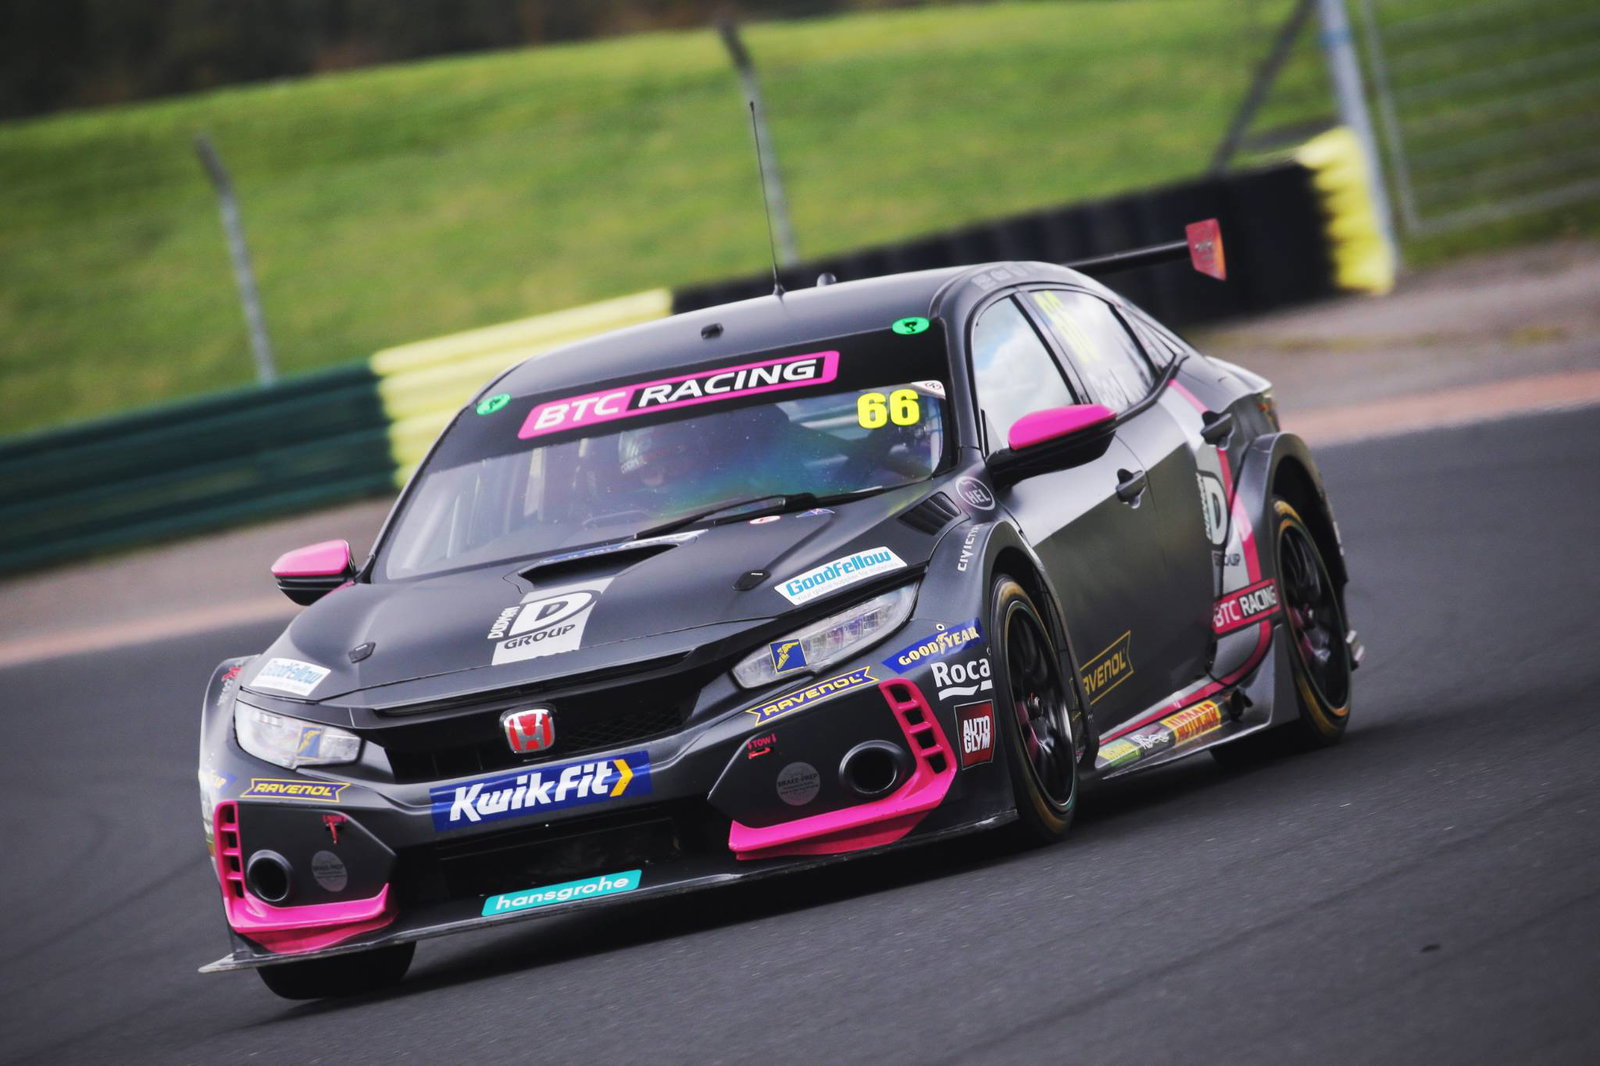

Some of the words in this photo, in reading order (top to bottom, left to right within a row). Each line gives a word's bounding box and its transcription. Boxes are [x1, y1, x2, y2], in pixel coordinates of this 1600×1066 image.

[534, 392, 627, 431] BTC
[638, 358, 818, 408] RACING
[857, 389, 920, 429] 66
[785, 548, 891, 597] GoodFellow
[1213, 600, 1240, 628] BTC
[504, 624, 576, 650] GROUP
[898, 626, 980, 666] GOODYEAR
[930, 657, 991, 687] Roca
[762, 675, 863, 716] RAVENOL
[963, 716, 990, 737] AUTO
[964, 732, 991, 754] GLYM
[253, 783, 333, 797] RAVENOL
[495, 876, 629, 910] hansgrohe
